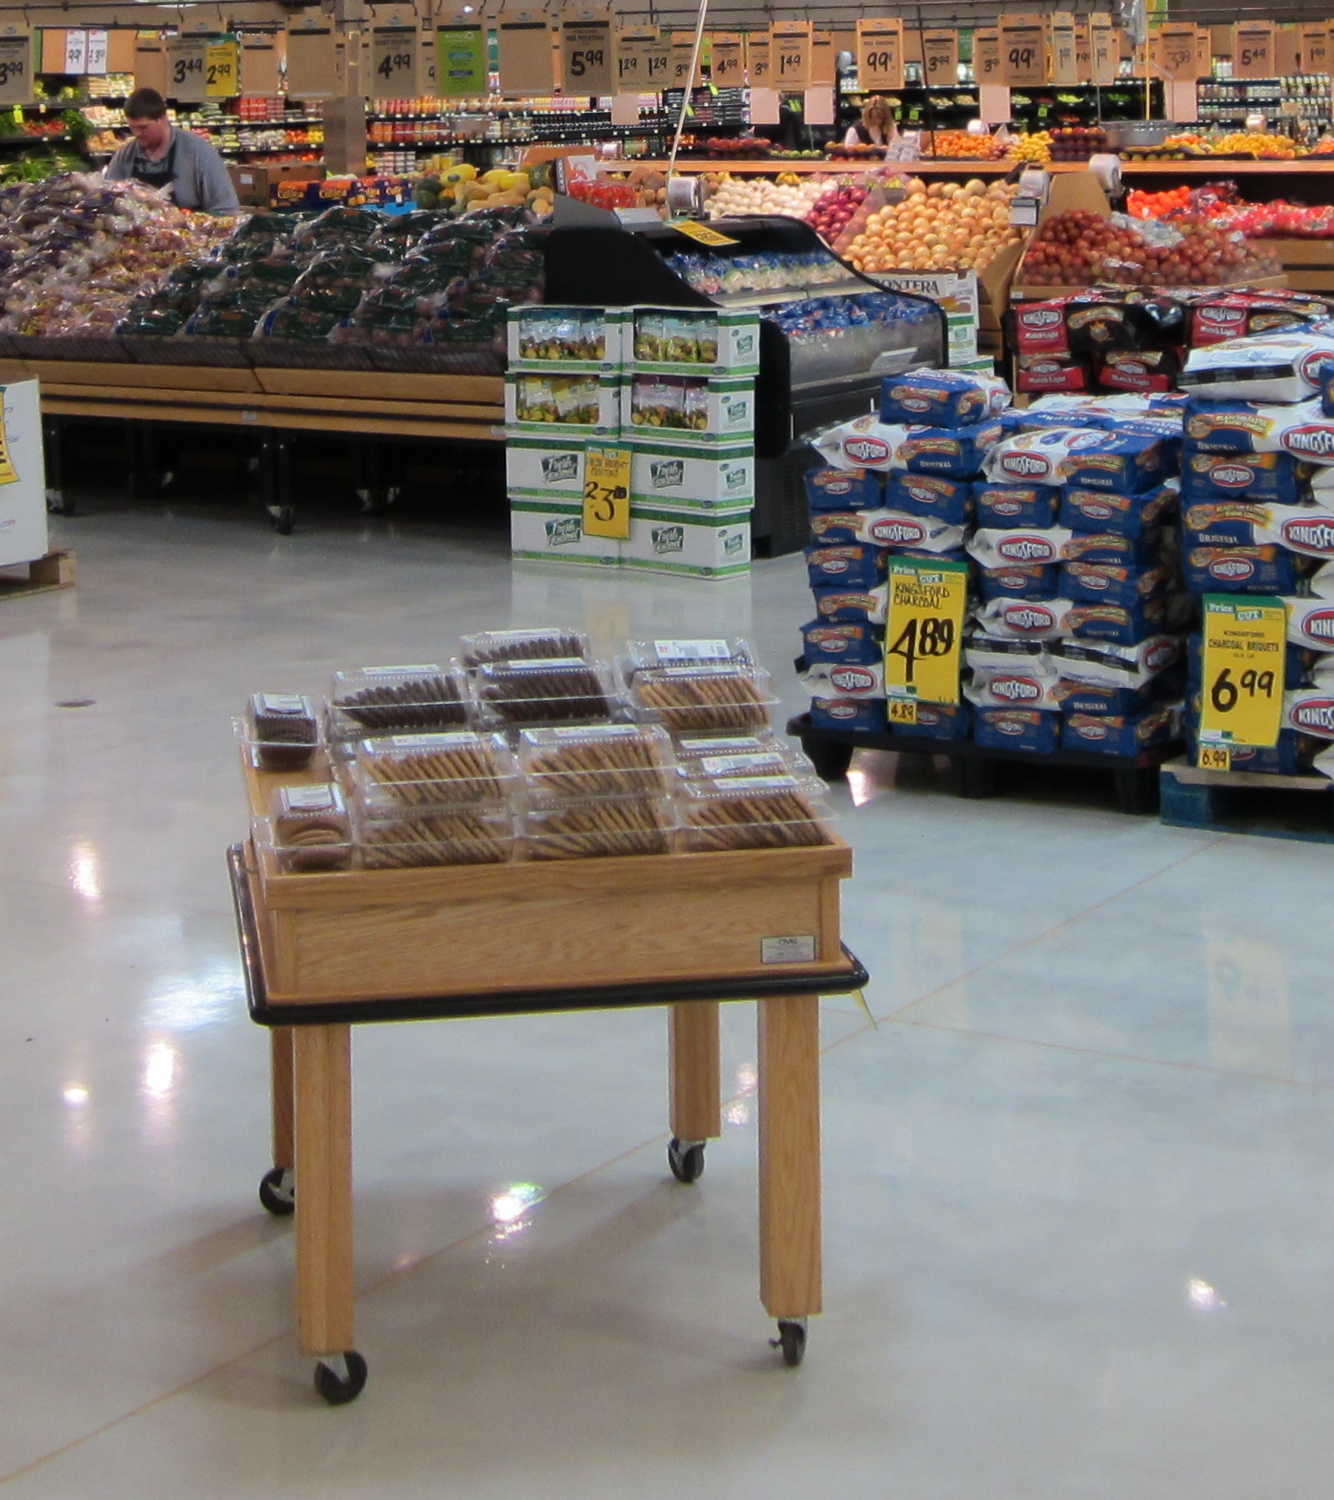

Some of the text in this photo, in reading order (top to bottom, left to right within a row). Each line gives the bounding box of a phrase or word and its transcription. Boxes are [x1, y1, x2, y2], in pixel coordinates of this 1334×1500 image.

[845, 441, 887, 461] KINGSFORD
[1003, 456, 1047, 475] KINGSFORD
[873, 521, 922, 542] KINGSFORD
[1001, 540, 1050, 559] KINGSFORD
[893, 566, 941, 584] Price CUT
[895, 582, 950, 598] KINGSFORD
[893, 595, 943, 610] CHARCOAL
[1005, 609, 1051, 629] KINGSFORD
[1208, 603, 1261, 621] Price CUT
[1208, 638, 1244, 650] CHARCOAL
[831, 670, 872, 688] KINGSFORD
[991, 679, 1038, 699] KINGSFORD
[1211, 667, 1275, 713] 699
[891, 703, 914, 720] 4.89
[1202, 751, 1227, 766] 6.99
